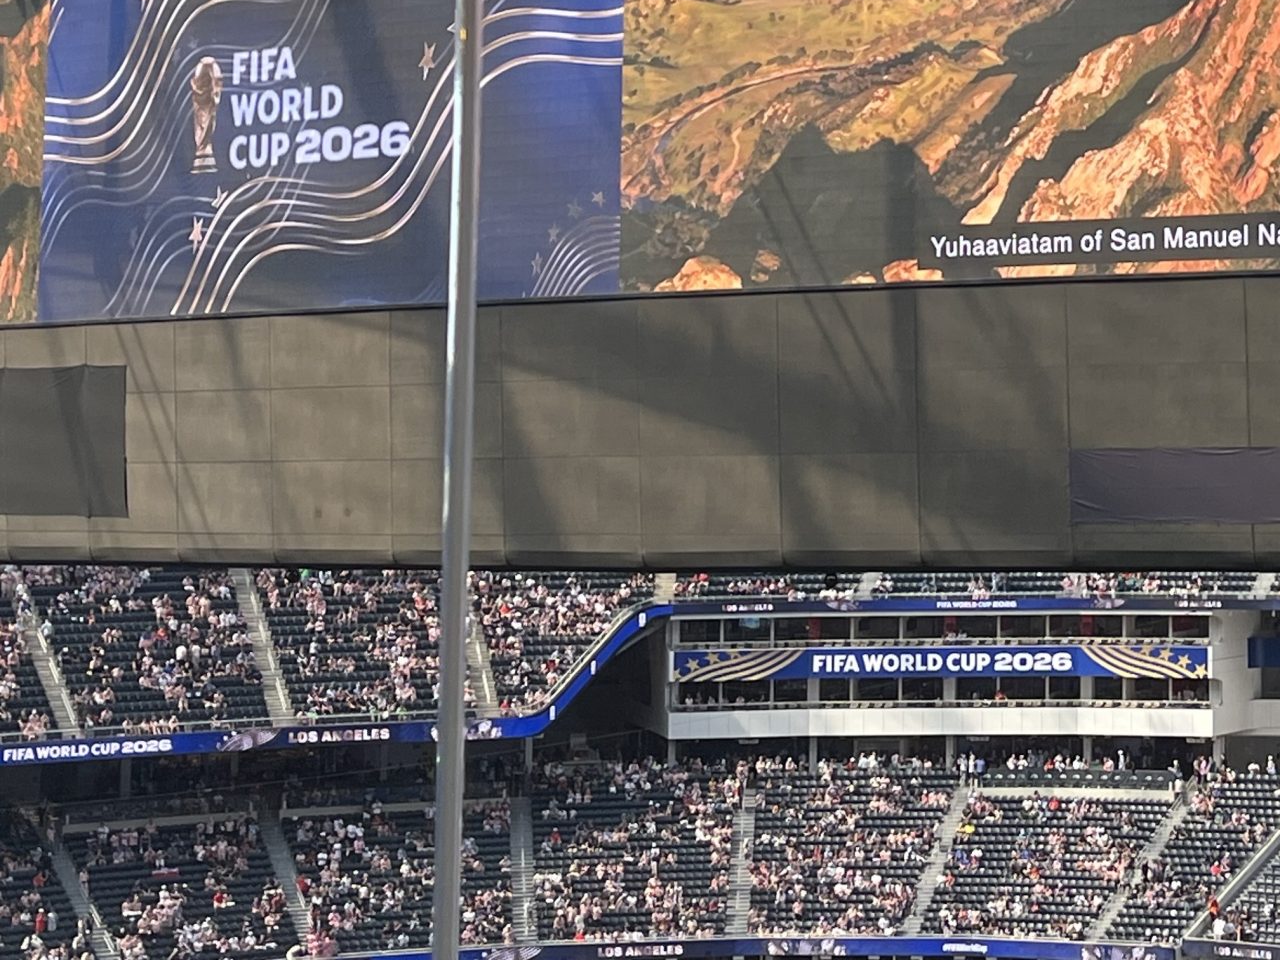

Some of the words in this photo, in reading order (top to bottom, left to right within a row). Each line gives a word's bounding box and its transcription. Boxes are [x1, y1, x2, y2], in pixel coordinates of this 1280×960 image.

[231, 46, 297, 86] FIFA
[230, 84, 344, 127] WORLD
[229, 132, 290, 170] CUP
[295, 121, 411, 164] 2026
[930, 233, 1073, 258] Yuhaaviatam
[1080, 229, 1103, 252] of
[1110, 228, 1155, 252] San
[1163, 224, 1249, 249] Manuel
[812, 653, 860, 673] FIFA
[862, 653, 943, 673] WORLD
[946, 652, 992, 672] CUP
[993, 652, 1073, 672] 2026
[288, 730, 318, 744] LOS
[321, 728, 390, 743] ANGELES
[3, 746, 34, 762] FIFA
[36, 743, 90, 759] WORLD
[91, 742, 120, 756] CUP
[121, 739, 173, 754] 2026
[597, 946, 623, 958] LOS
[625, 944, 683, 957] ANGELES
